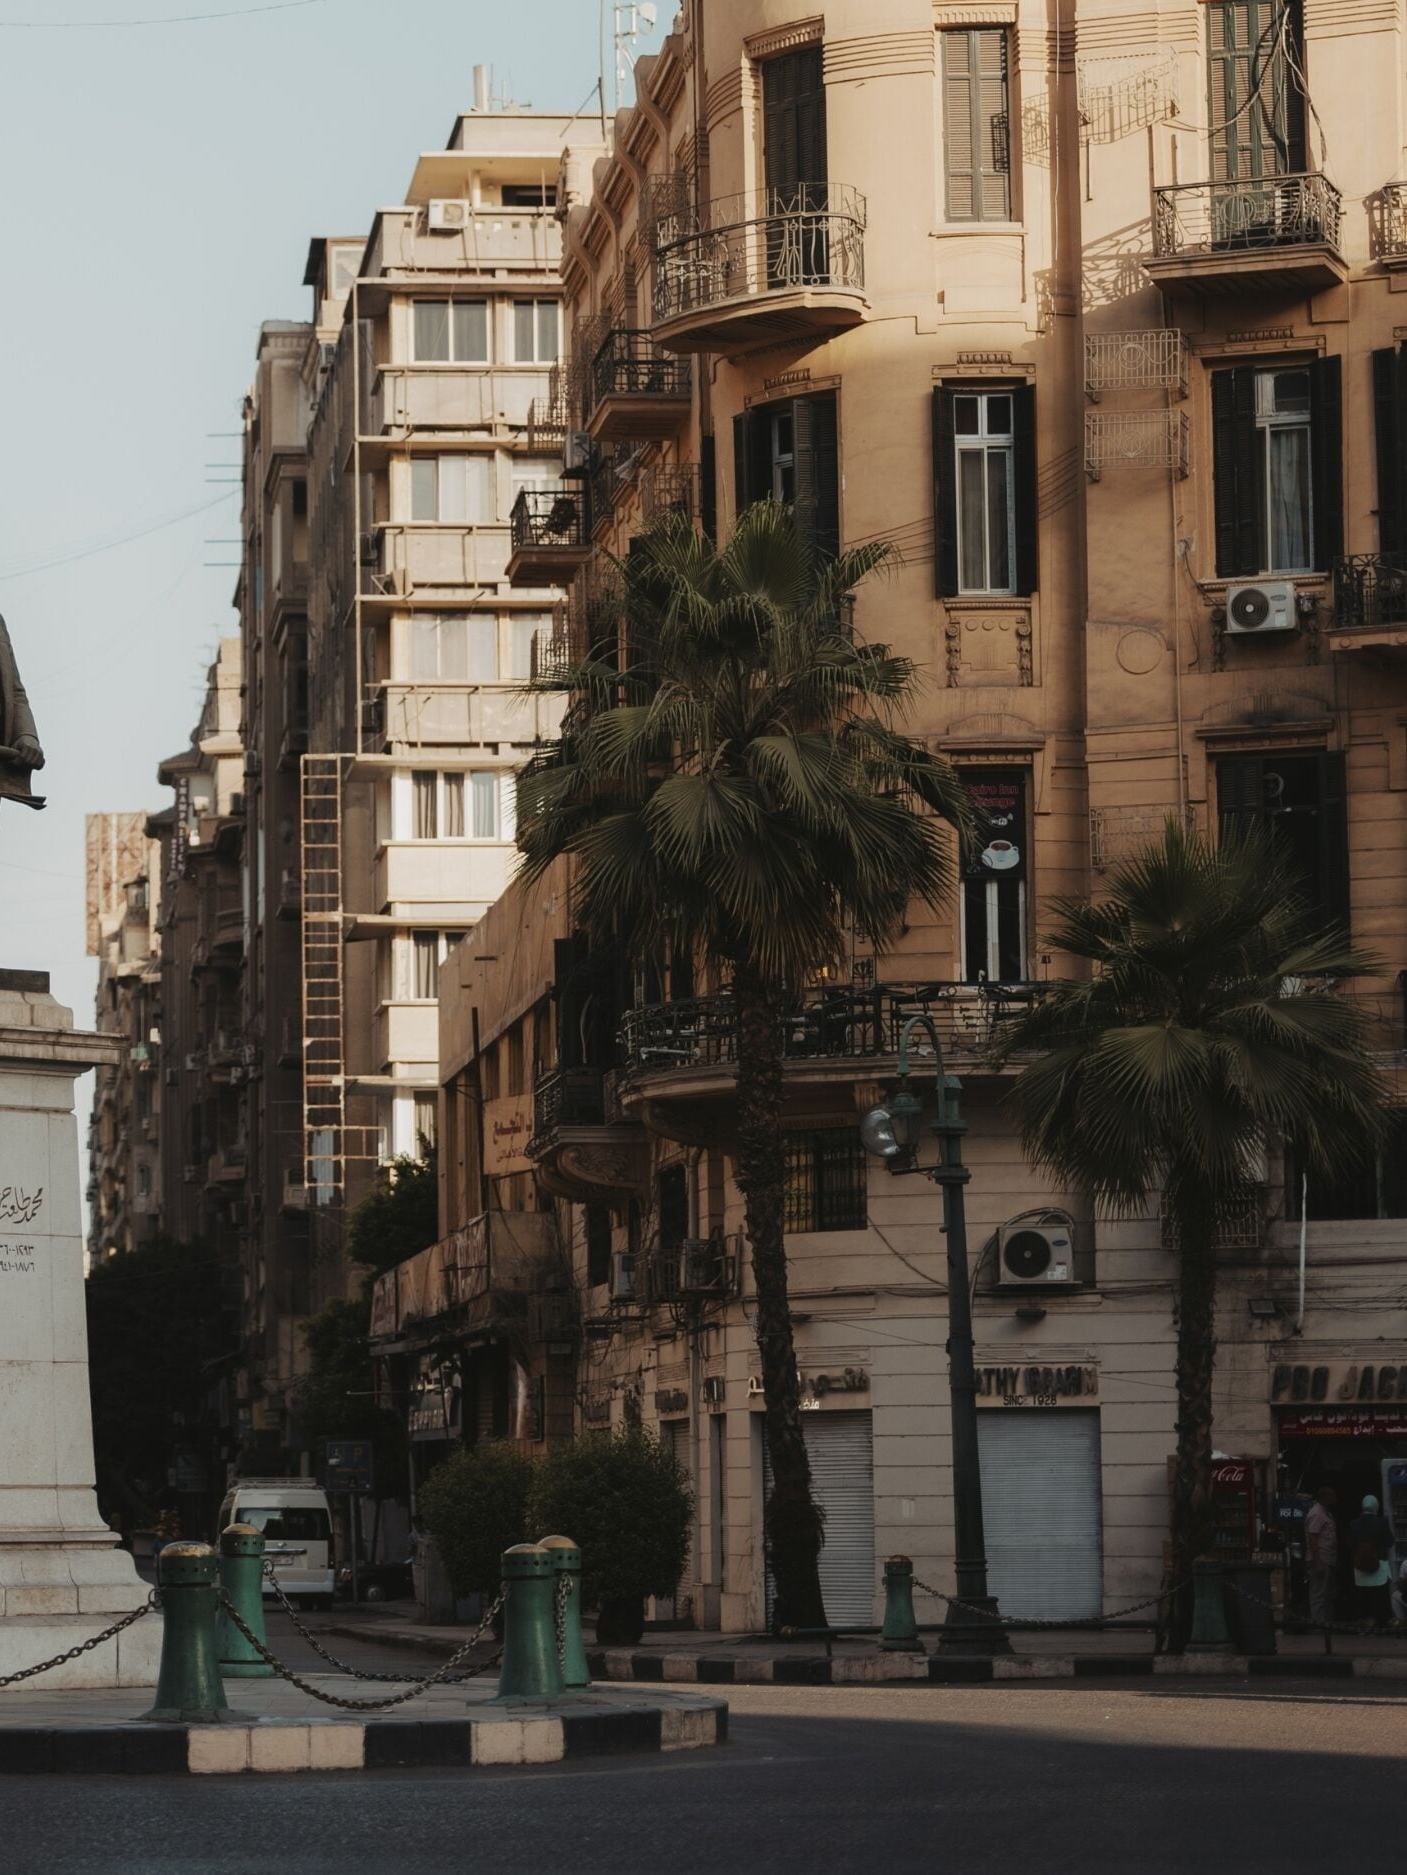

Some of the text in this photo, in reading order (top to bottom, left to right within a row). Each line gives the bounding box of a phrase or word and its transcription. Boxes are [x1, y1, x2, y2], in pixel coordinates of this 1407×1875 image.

[11, 1187, 43, 1224] محمد
[973, 1367, 1020, 1396] ATHY
[1273, 1365, 1330, 1402] PRO
[1032, 1394, 1057, 1406] 1928
